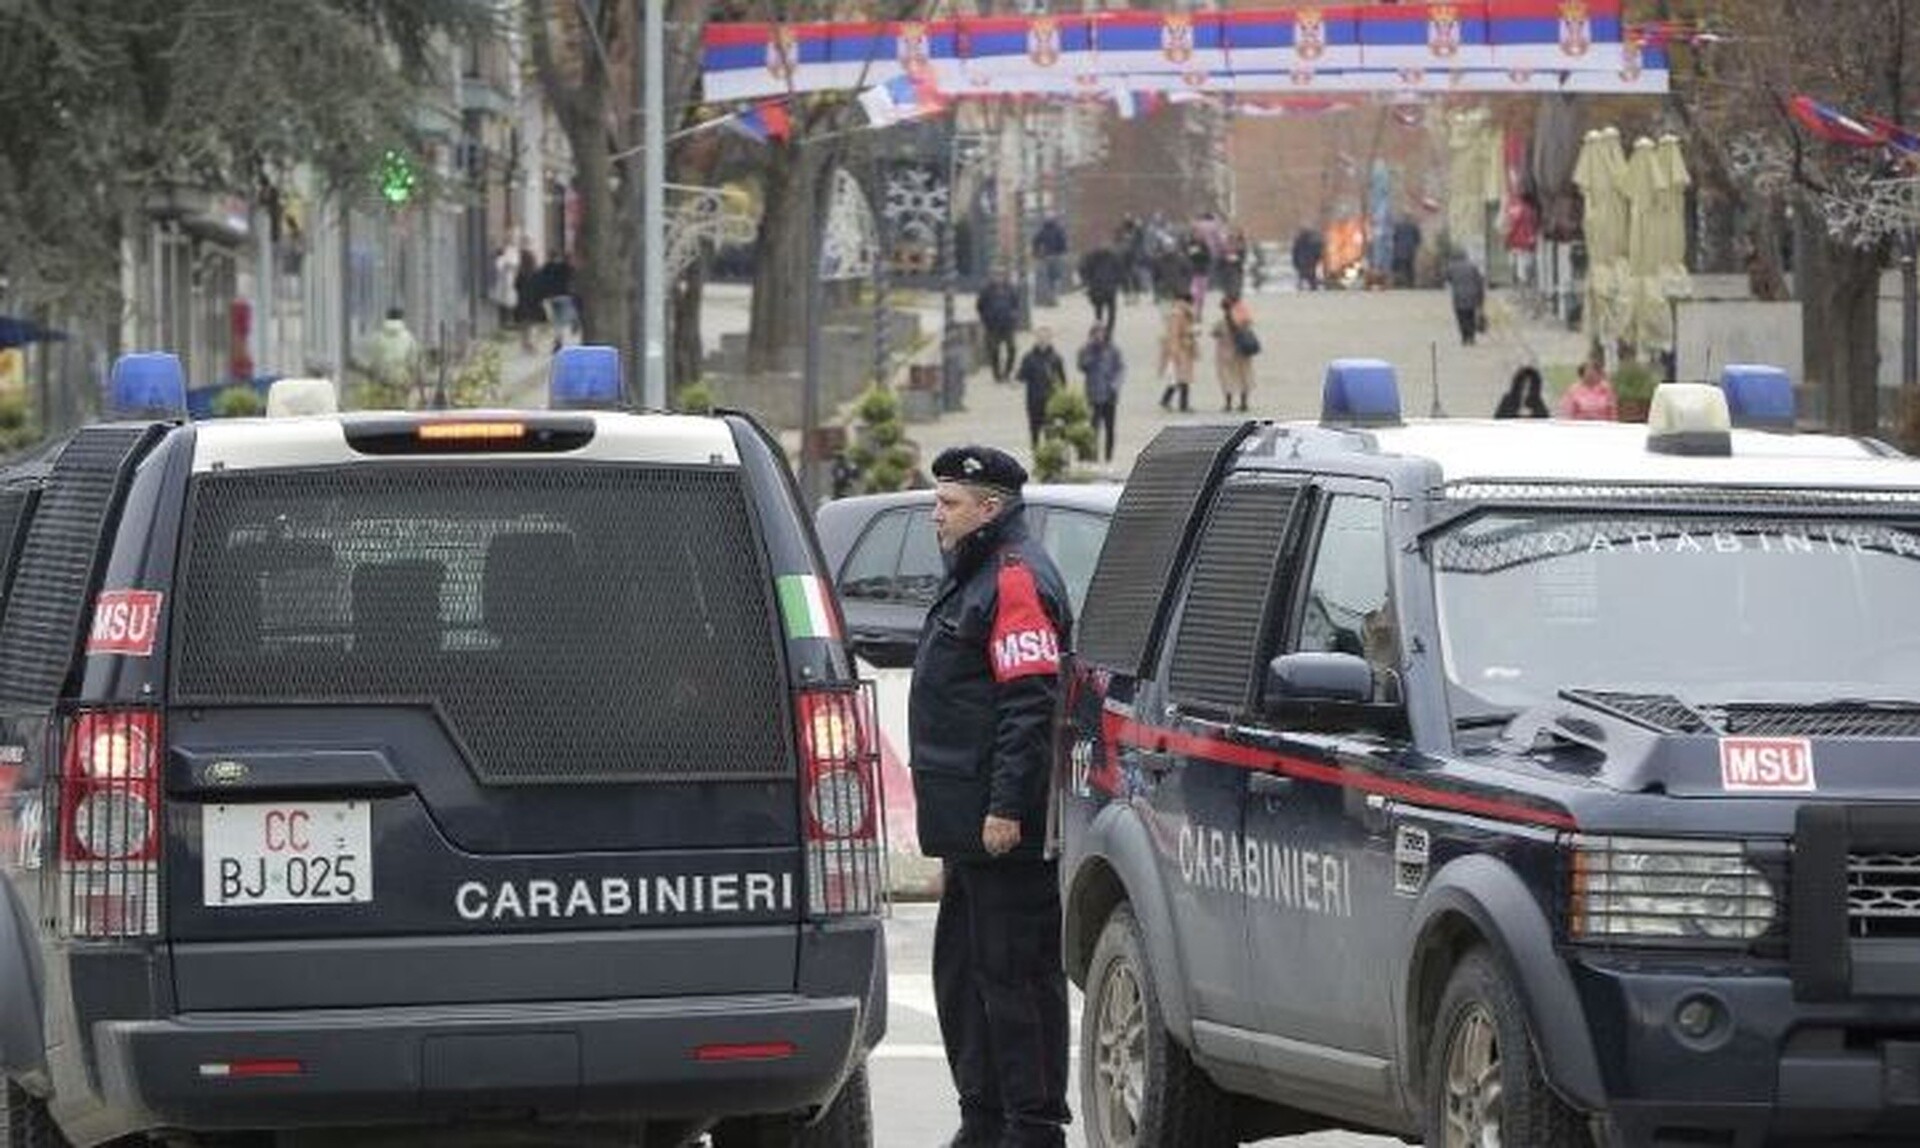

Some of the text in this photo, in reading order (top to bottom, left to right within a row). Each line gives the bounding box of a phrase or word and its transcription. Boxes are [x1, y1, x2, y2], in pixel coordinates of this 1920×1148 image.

[92, 602, 150, 643] MSU
[995, 629, 1059, 668] MSU
[1728, 747, 1804, 781] MSU
[265, 810, 309, 852] CC
[220, 853, 356, 898] BJ 025
[1179, 825, 1351, 917] CARABINIERI
[455, 873, 793, 919] CARABINIERI
